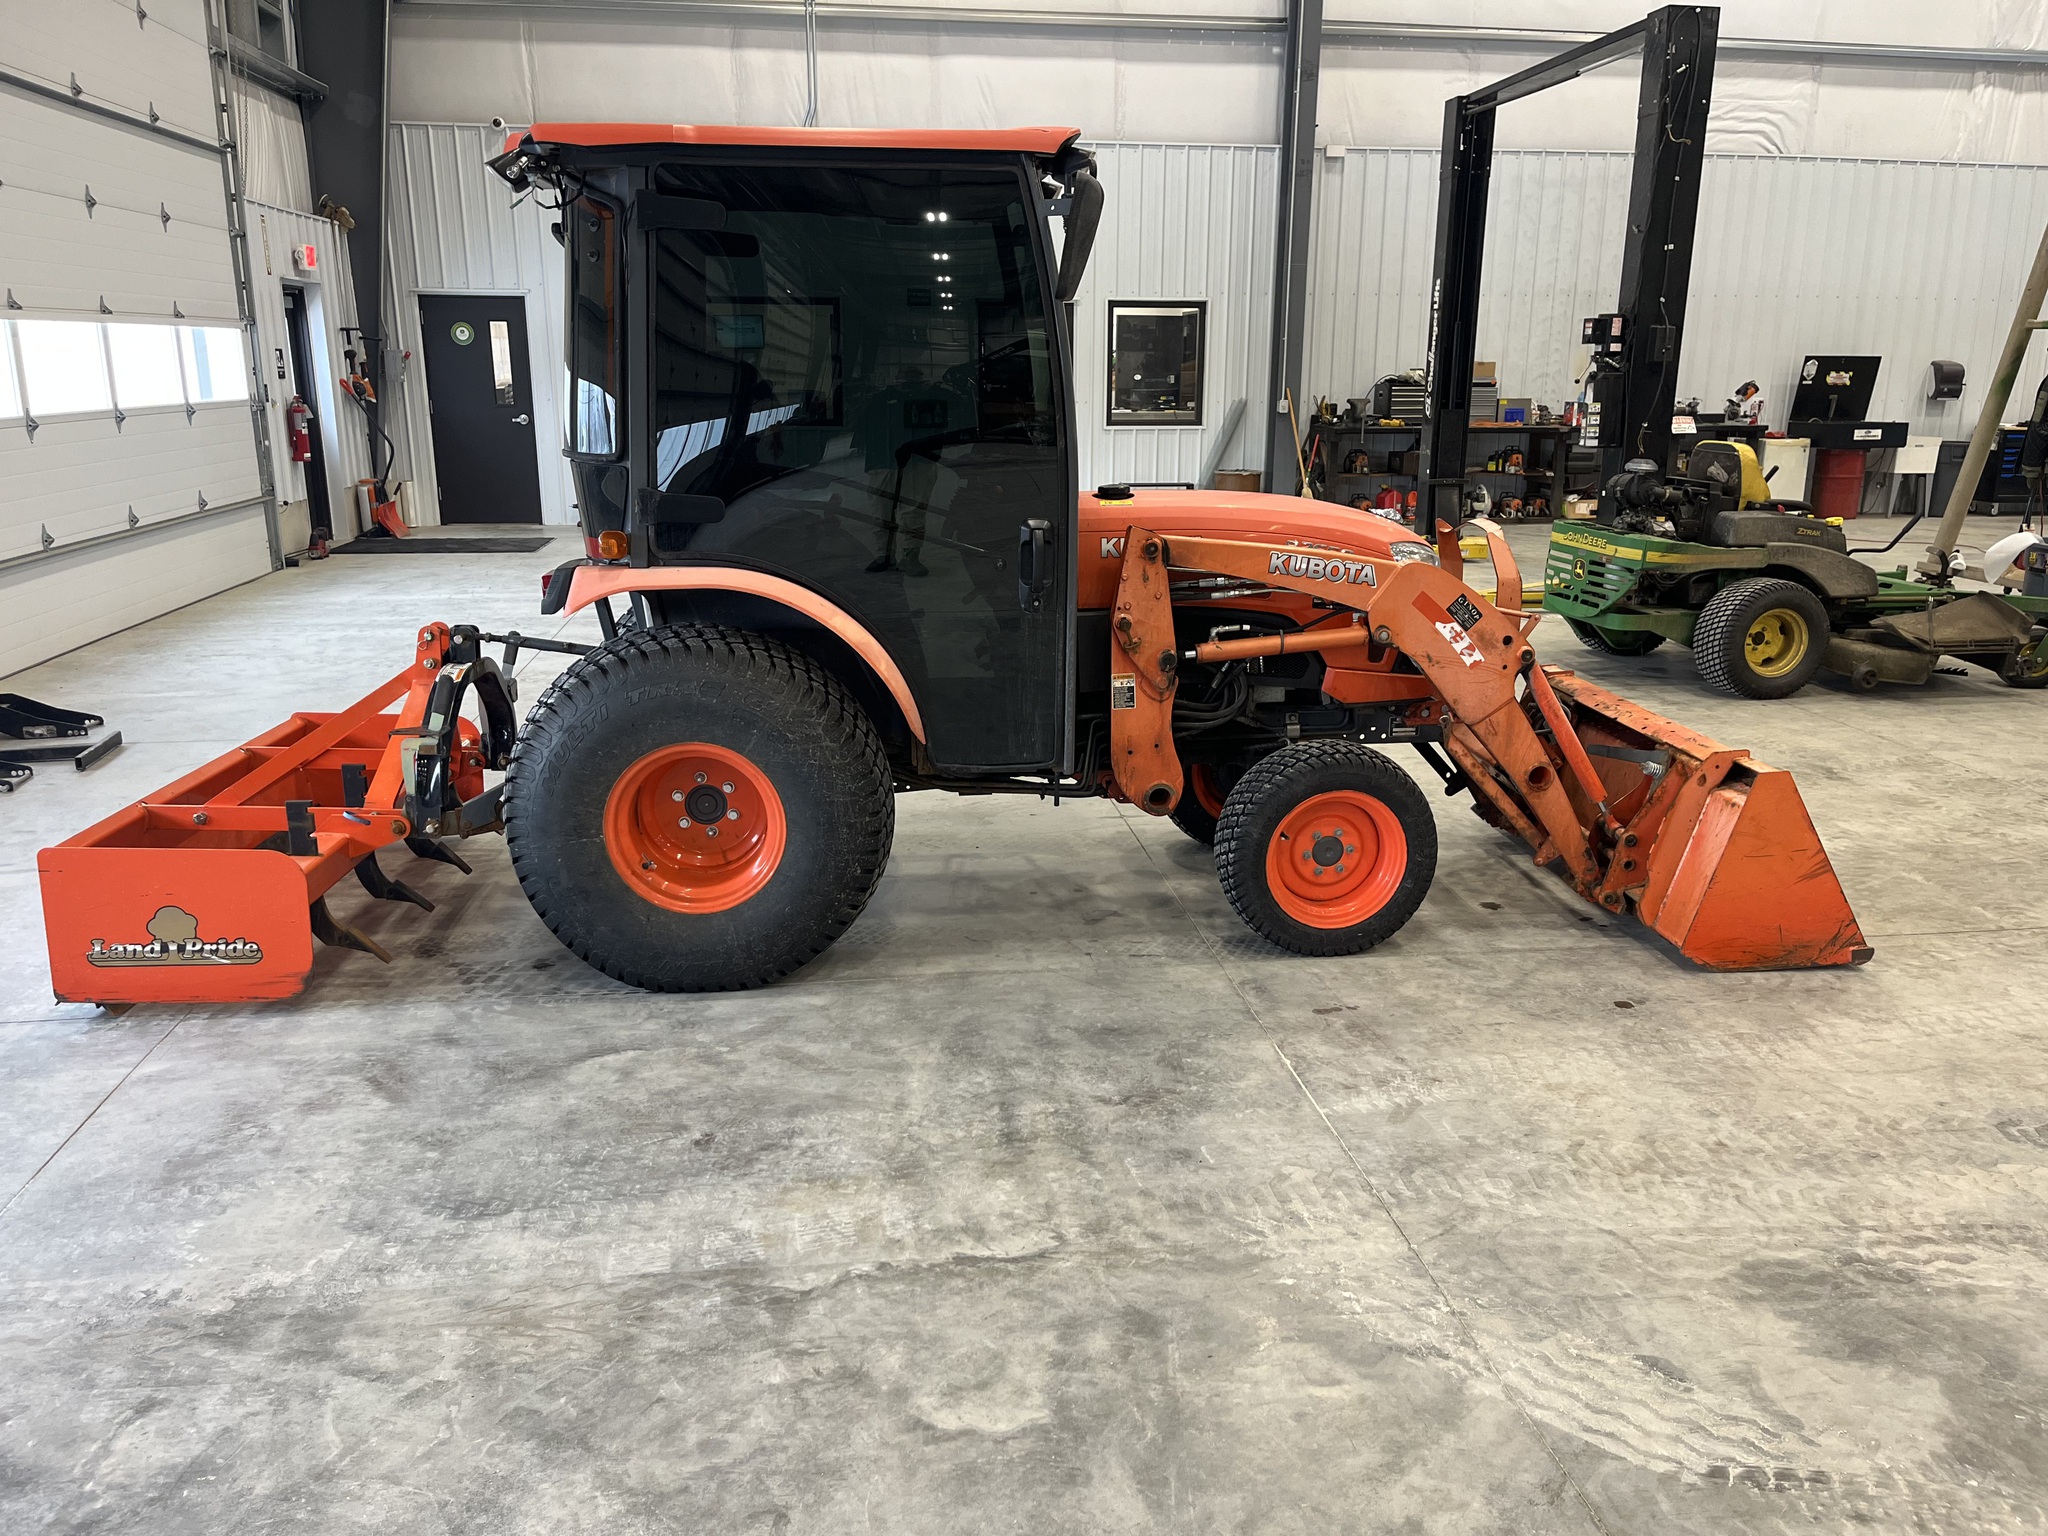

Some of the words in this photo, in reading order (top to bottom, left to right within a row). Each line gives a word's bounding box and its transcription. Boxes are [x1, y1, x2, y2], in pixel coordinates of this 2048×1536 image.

[1427, 310, 1438, 392] Challenger
[1433, 278, 1441, 310] Lifts
[1563, 531, 1583, 544] JOHN
[1583, 533, 1607, 549] DEERE
[1268, 551, 1377, 588] KUBOTA
[541, 702, 609, 797] MULTI
[625, 681, 727, 706] TRAC
[89, 938, 163, 960] Land
[183, 937, 260, 960] Pride
